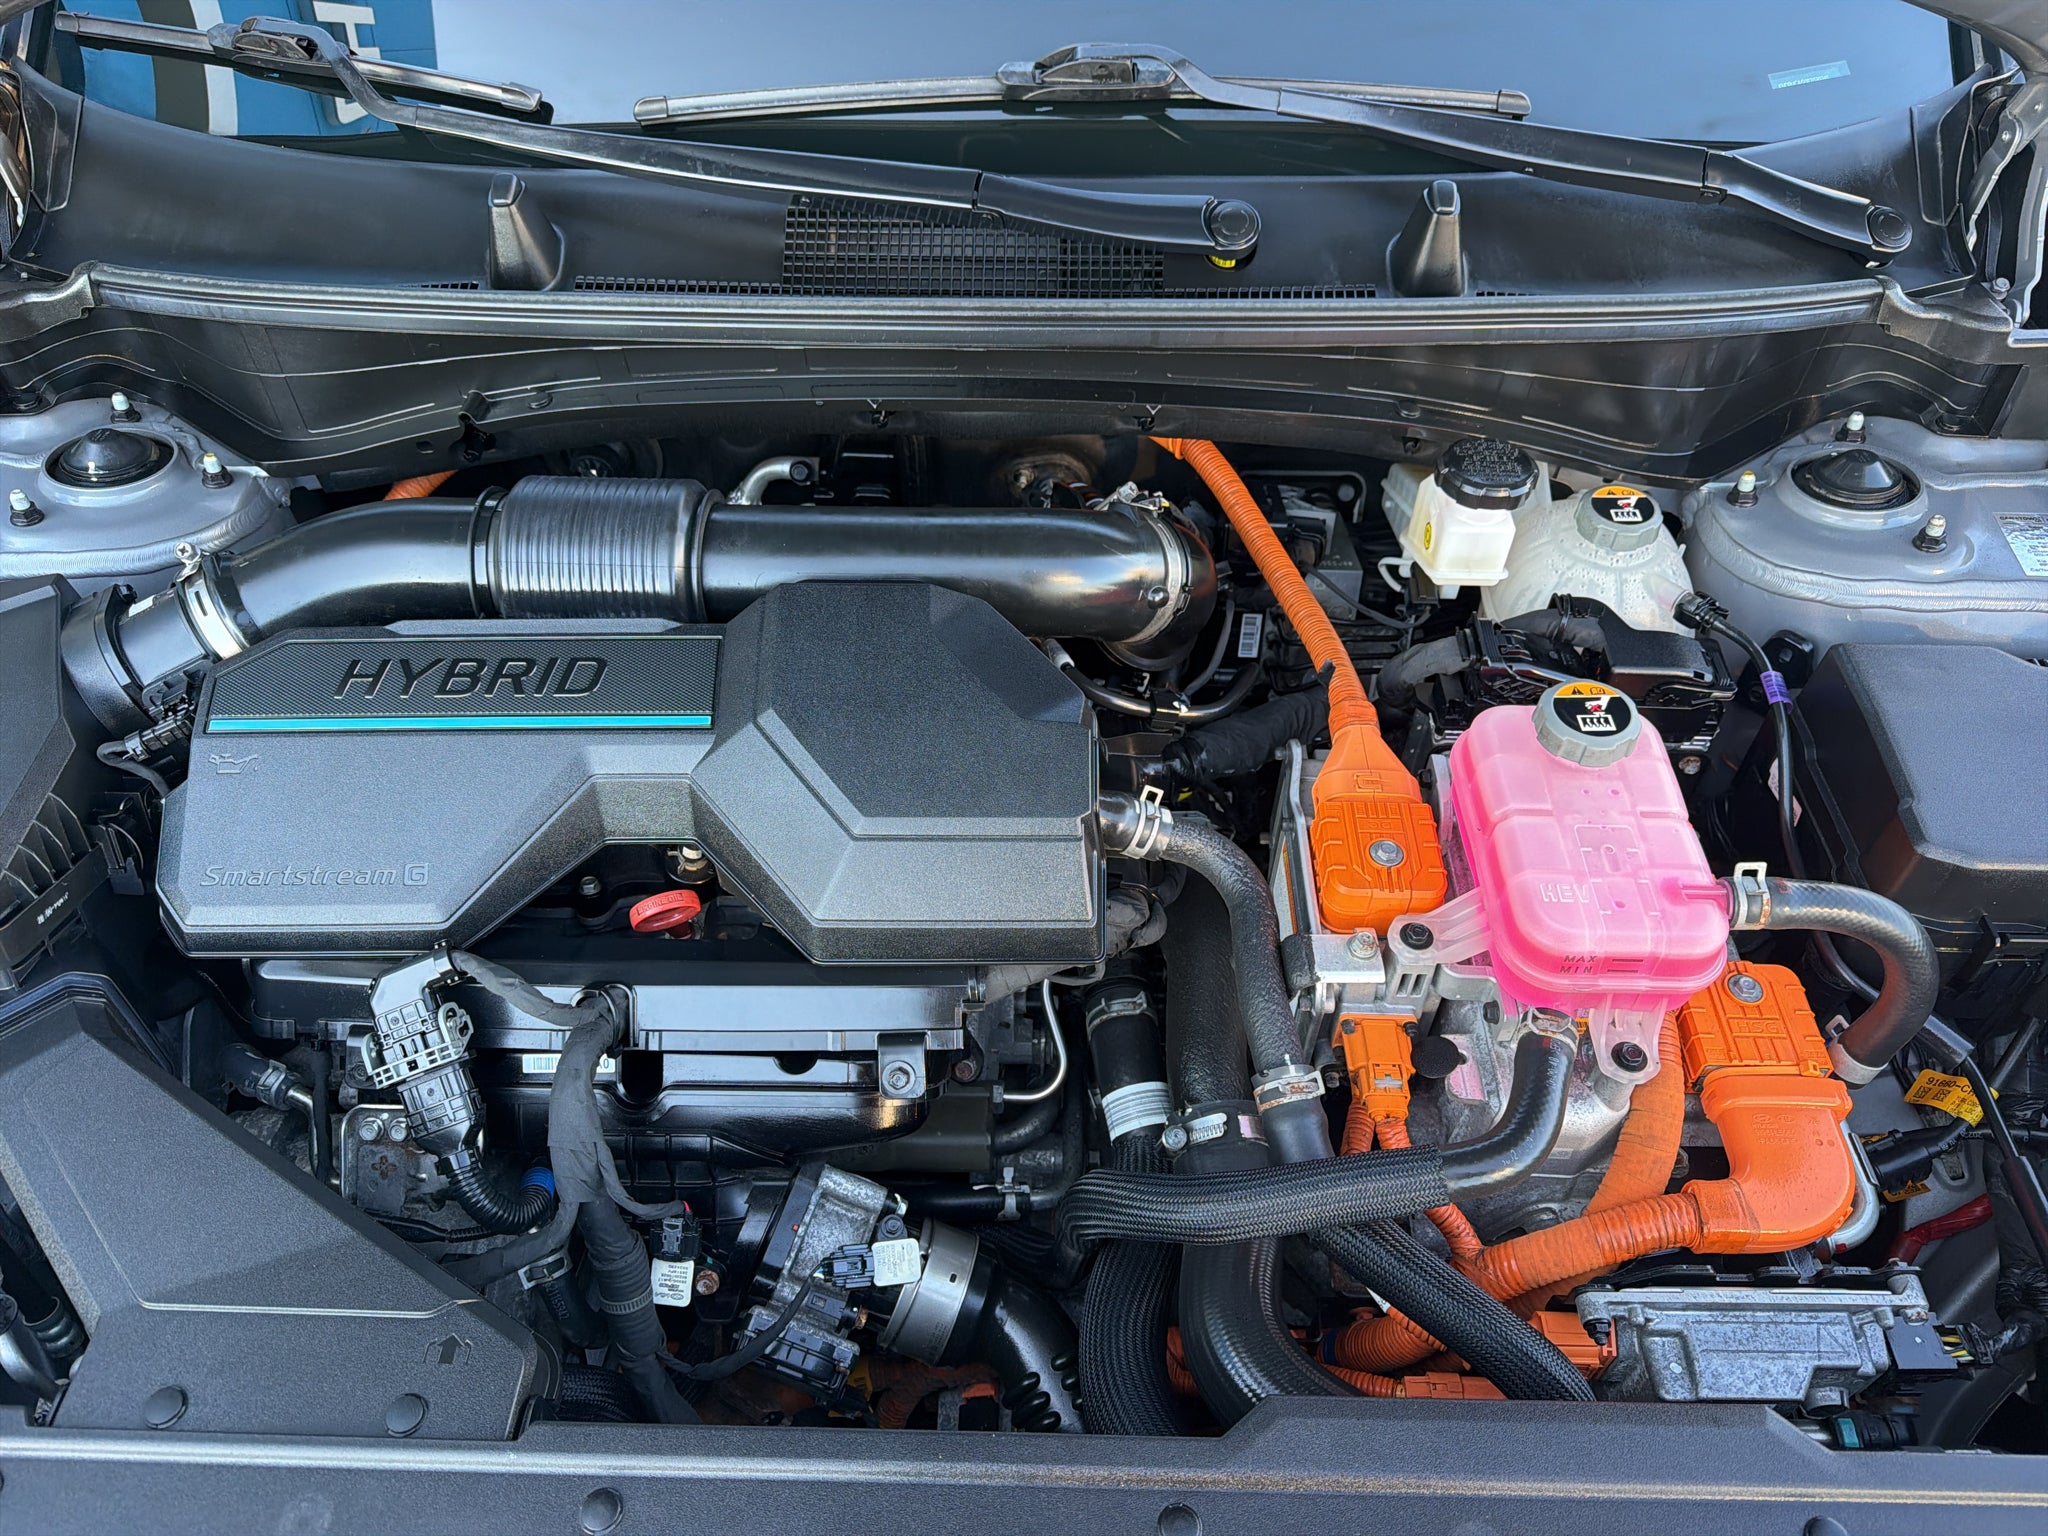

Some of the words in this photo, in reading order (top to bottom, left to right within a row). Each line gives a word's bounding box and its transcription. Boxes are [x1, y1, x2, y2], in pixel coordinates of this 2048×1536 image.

[334, 656, 608, 698] HYBRID
[200, 864, 397, 887] Smartstream
[403, 862, 430, 887] G
[1539, 883, 1590, 904] HEV
[1563, 955, 1598, 964] MAX
[1559, 965, 1593, 974] MIN
[1736, 1020, 1779, 1034] HSG
